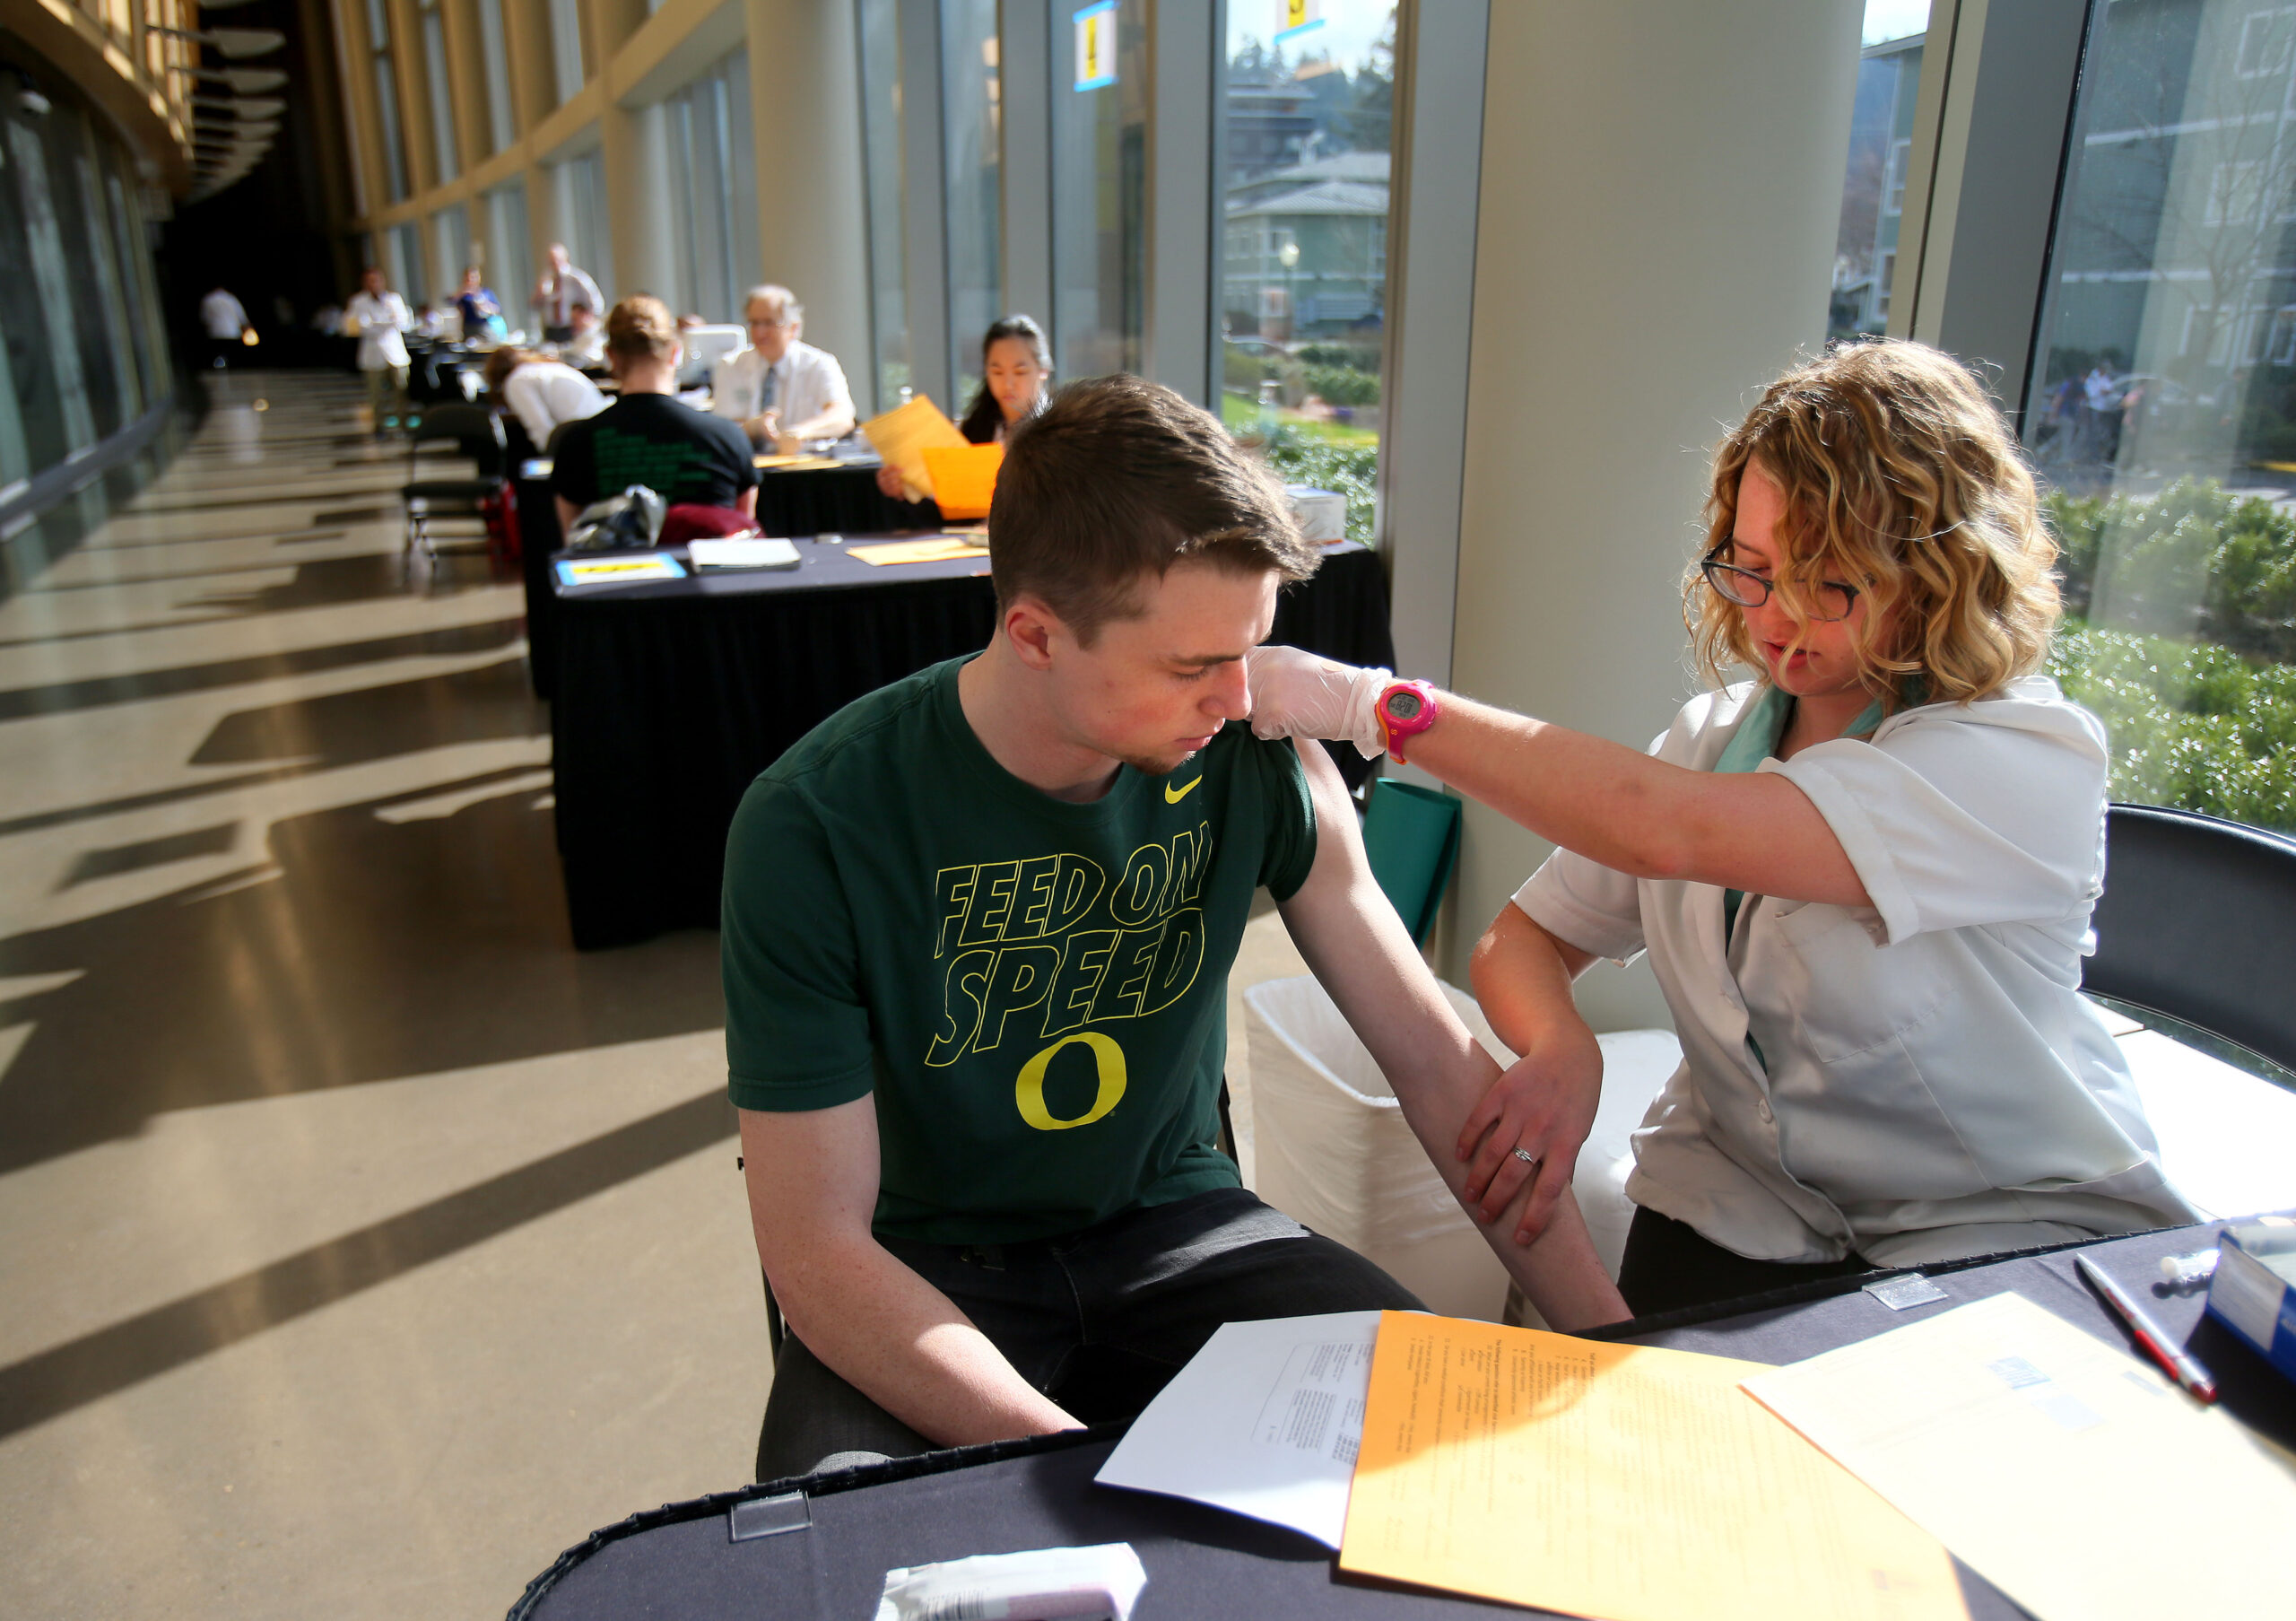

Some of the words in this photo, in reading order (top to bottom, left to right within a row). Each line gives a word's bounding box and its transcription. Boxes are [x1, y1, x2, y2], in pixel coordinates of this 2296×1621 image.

[935, 853, 1106, 959] FEED
[1109, 820, 1213, 926] ON
[925, 907, 1205, 1067] SPEED
[1015, 1031, 1127, 1130] O
